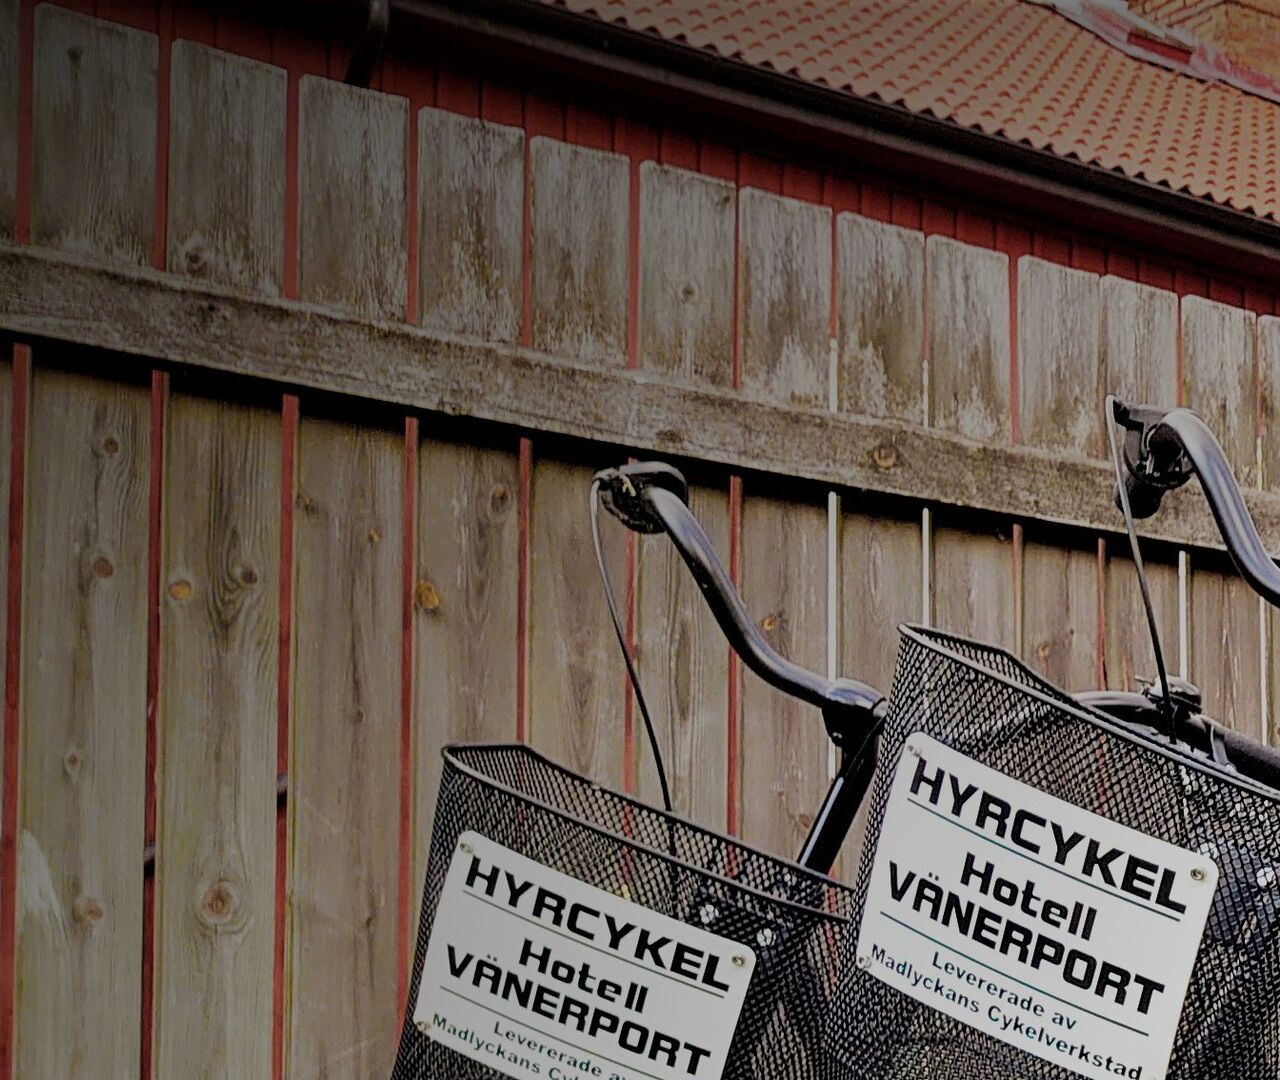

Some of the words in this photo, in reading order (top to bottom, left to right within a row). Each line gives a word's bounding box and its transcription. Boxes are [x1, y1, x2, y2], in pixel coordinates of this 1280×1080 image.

[911, 757, 1187, 914] HYRCYKEL
[465, 856, 730, 992] HYRCYKEL
[890, 860, 1165, 1014] VÄNERPORT
[960, 852, 1097, 941] Hotell
[447, 944, 711, 1075] VÄNERPORT
[519, 938, 648, 1013] Hotell
[871, 944, 979, 1012] Madlyckans
[988, 1006, 1142, 1080] Cykelverkstad
[932, 952, 1044, 1016] Levererade
[1052, 1013, 1076, 1029] av
[433, 1014, 539, 1073] Madlyckans
[494, 1022, 601, 1076] Levererade
